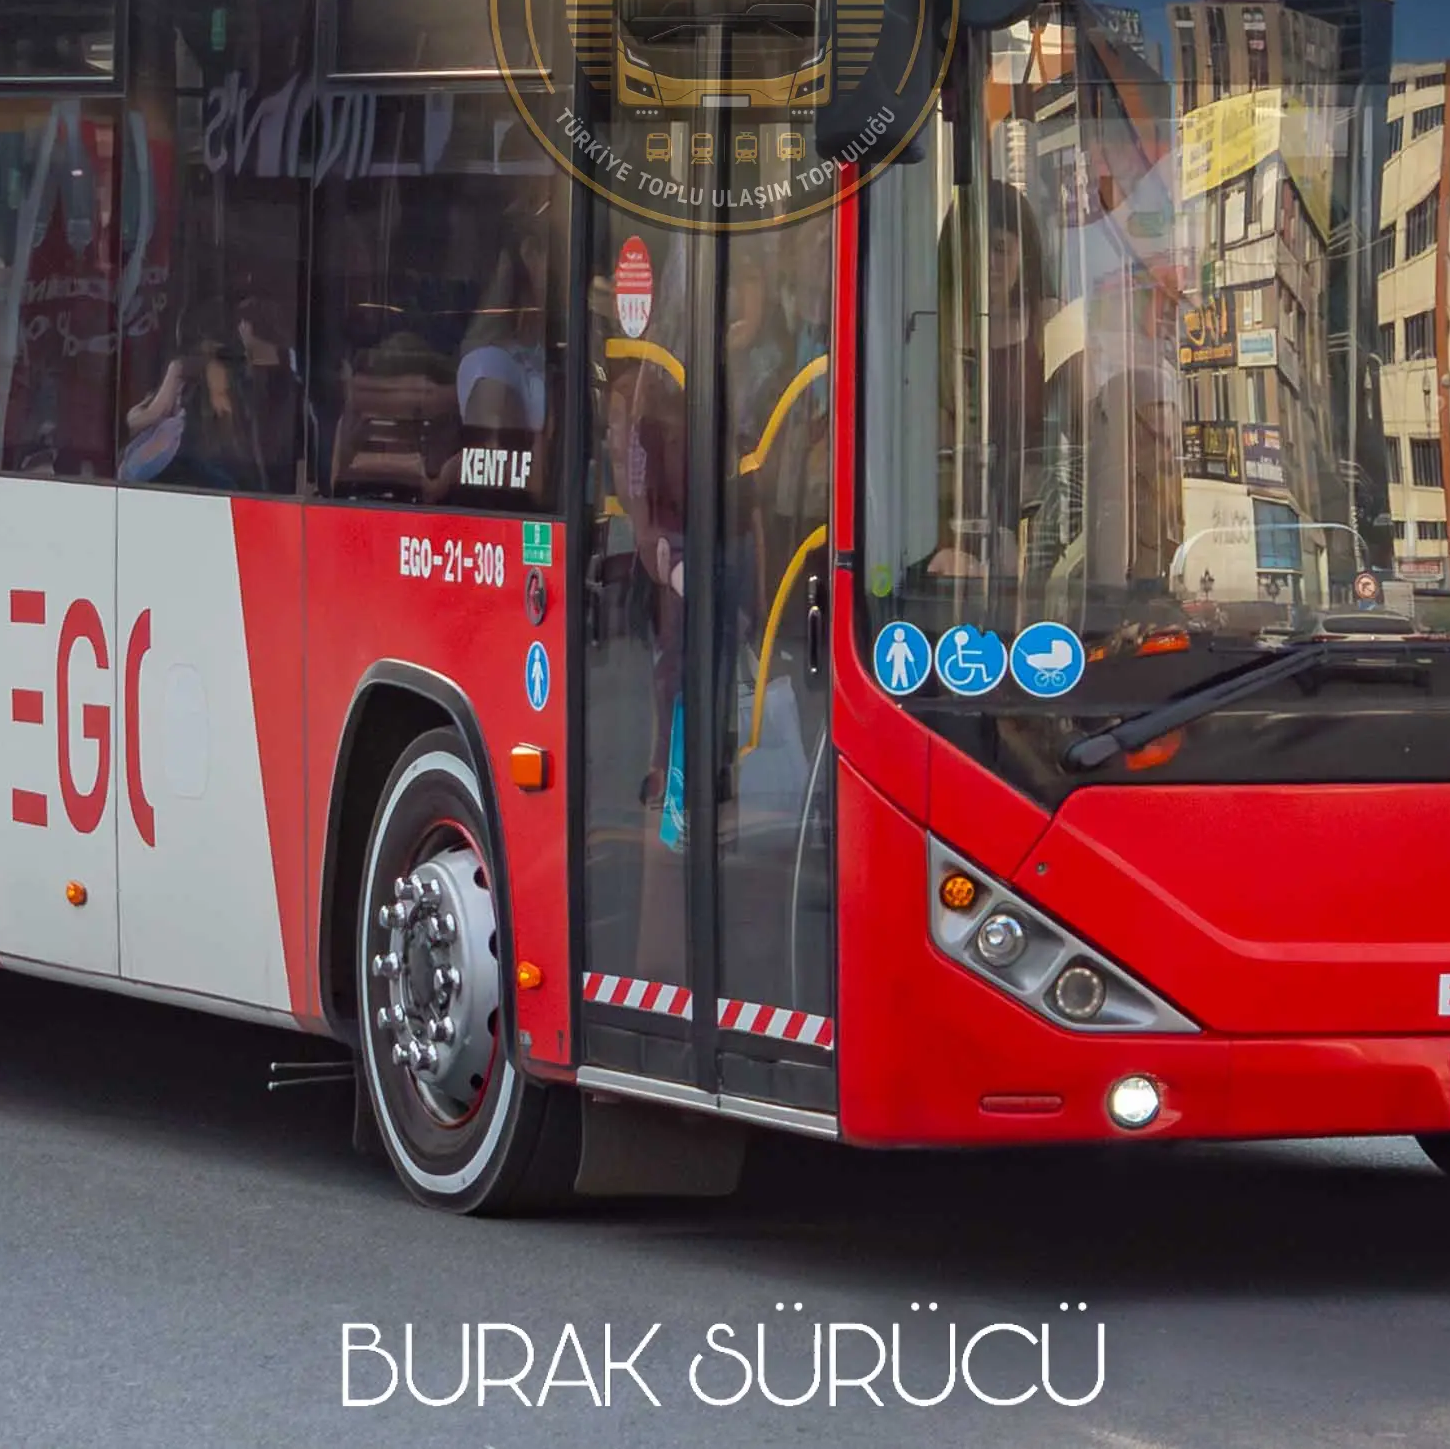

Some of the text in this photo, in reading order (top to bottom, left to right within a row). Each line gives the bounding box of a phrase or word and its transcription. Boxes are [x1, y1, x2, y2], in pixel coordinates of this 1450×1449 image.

[460, 447, 533, 489] KENT LF
[399, 535, 505, 588] EGO-21-308
